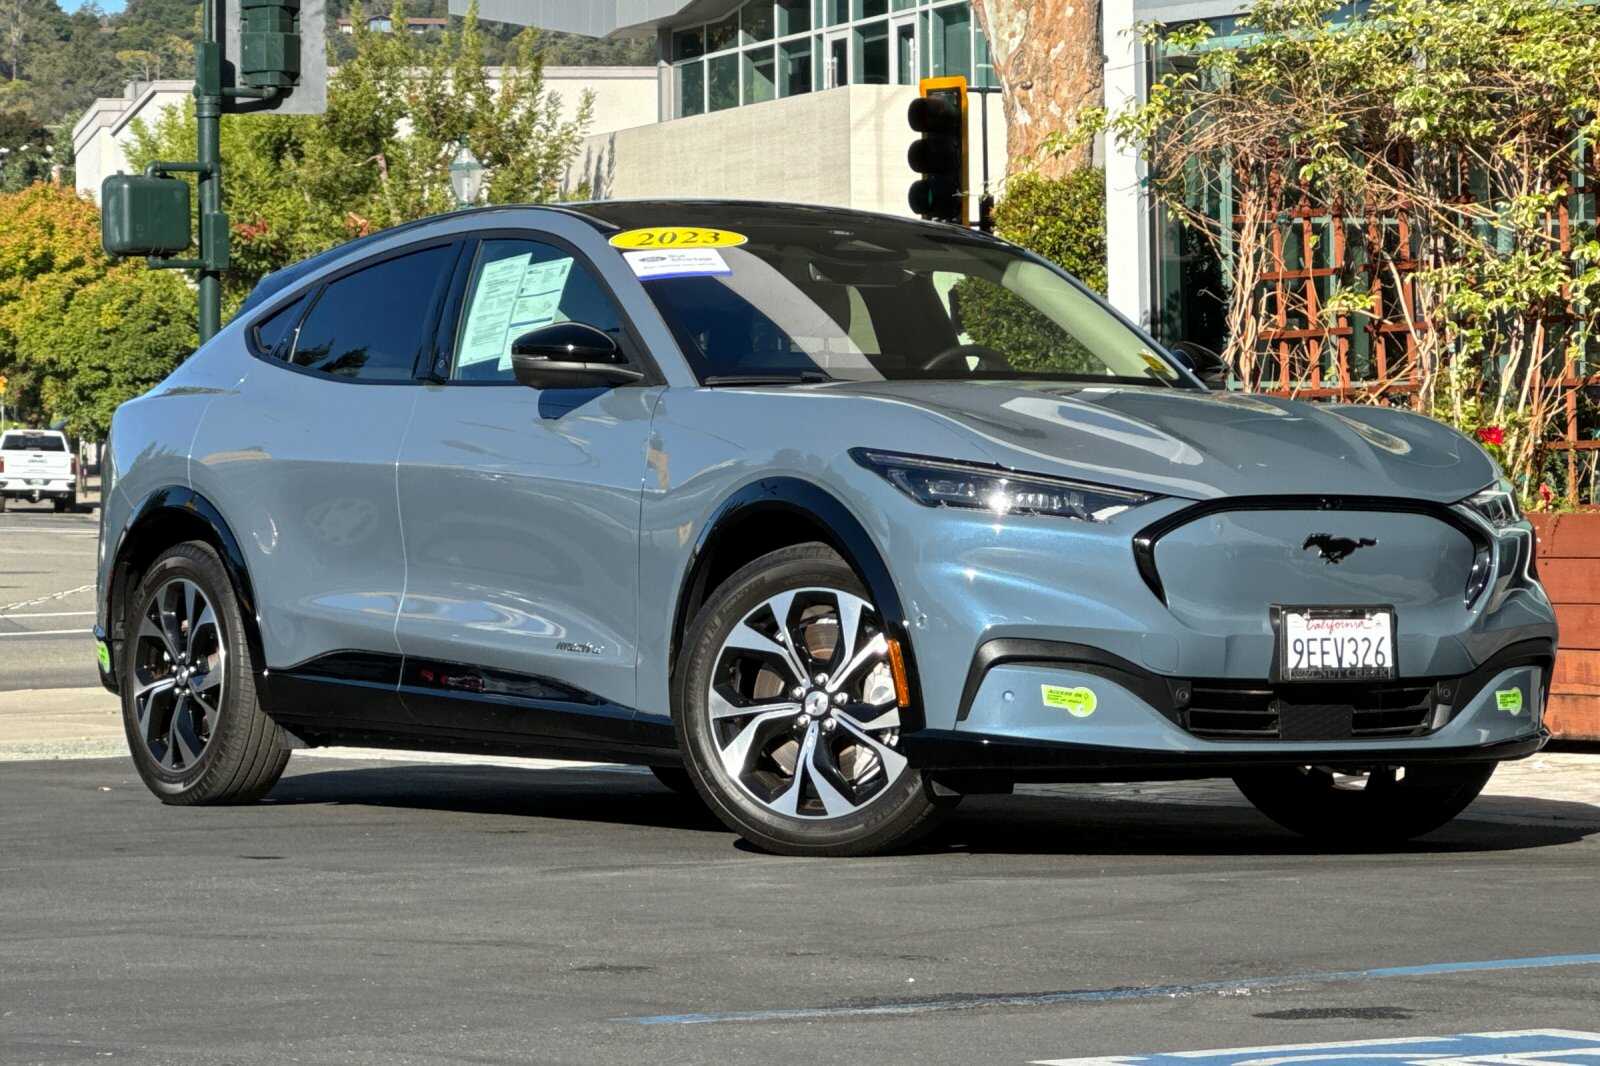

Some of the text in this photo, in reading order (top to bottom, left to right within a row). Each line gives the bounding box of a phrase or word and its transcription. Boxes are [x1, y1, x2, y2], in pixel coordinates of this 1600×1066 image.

[635, 231, 721, 246] 2023
[1306, 618, 1367, 635] California
[1292, 636, 1386, 669] 9EEV326
